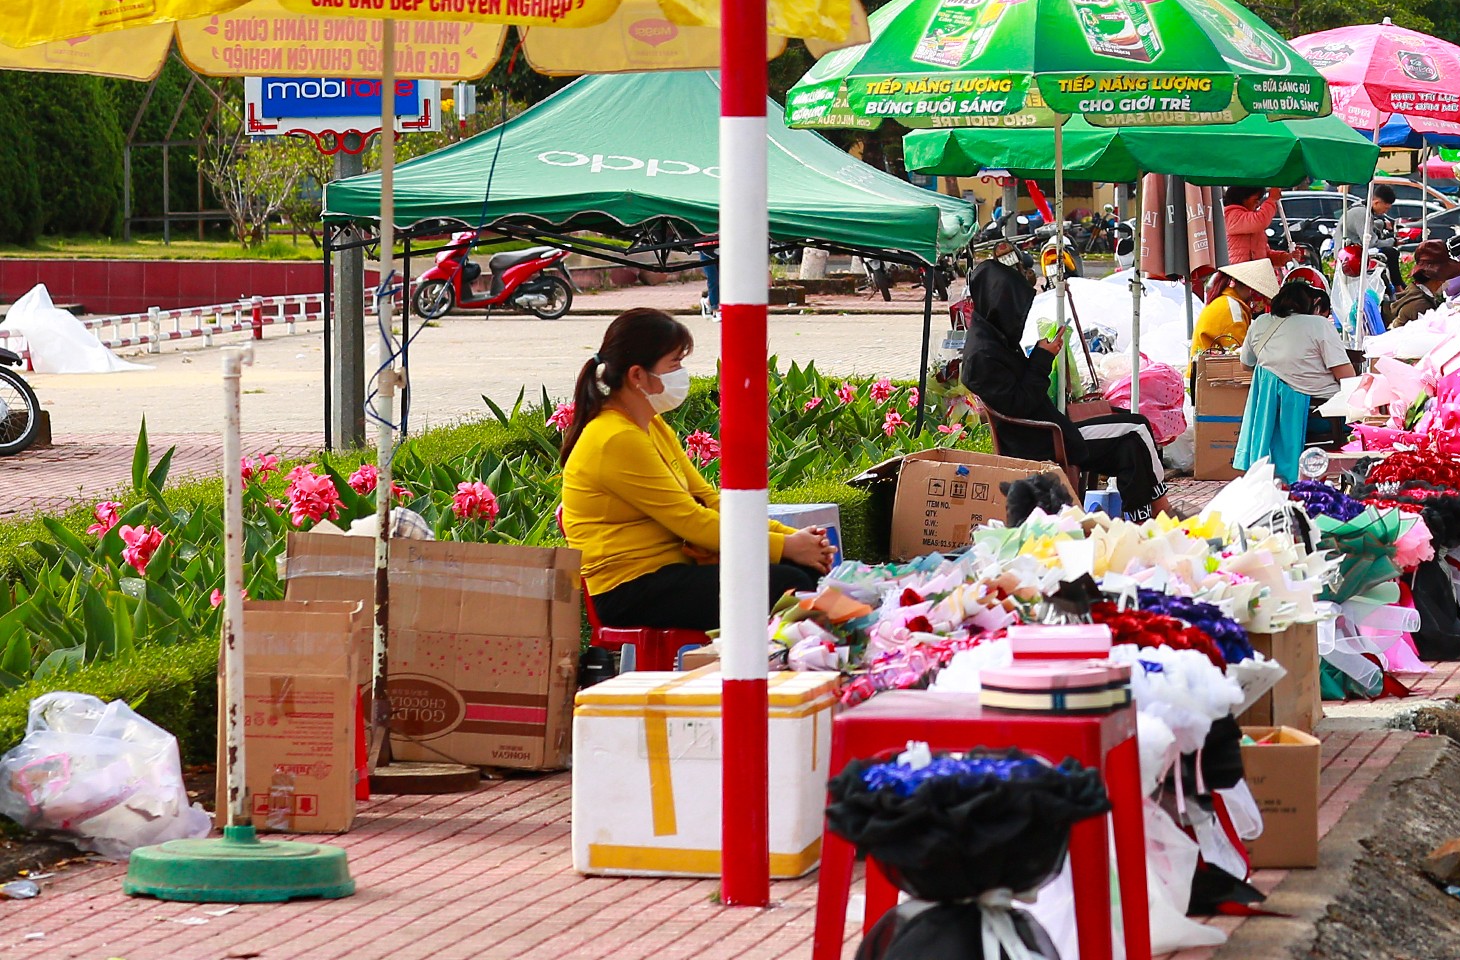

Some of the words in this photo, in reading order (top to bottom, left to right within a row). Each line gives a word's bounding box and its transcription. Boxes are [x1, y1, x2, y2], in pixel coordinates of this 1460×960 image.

[865, 76, 902, 96] TIẾP
[904, 77, 953, 94] NĂNG
[955, 76, 1013, 97] LƯỢNG
[1058, 75, 1097, 93] TIẾP
[1099, 75, 1149, 92] NĂNG
[1151, 76, 1212, 93] LƯỢNG
[1278, 78, 1299, 93] SÁNG
[865, 95, 913, 115] BỪNG
[916, 95, 956, 114] BUỔI
[959, 95, 1006, 113] SÁNG
[1078, 99, 1115, 113] CHO
[1118, 96, 1155, 112] GIỚI
[1158, 94, 1192, 111] TRẺ
[1280, 95, 1300, 110] BỮA
[1300, 97, 1320, 113] SÁNG
[926, 500, 940, 508] ITEM
[940, 501, 951, 510] NO.
[971, 513, 983, 522] PRS
[491, 749, 531, 761] HONGYA
